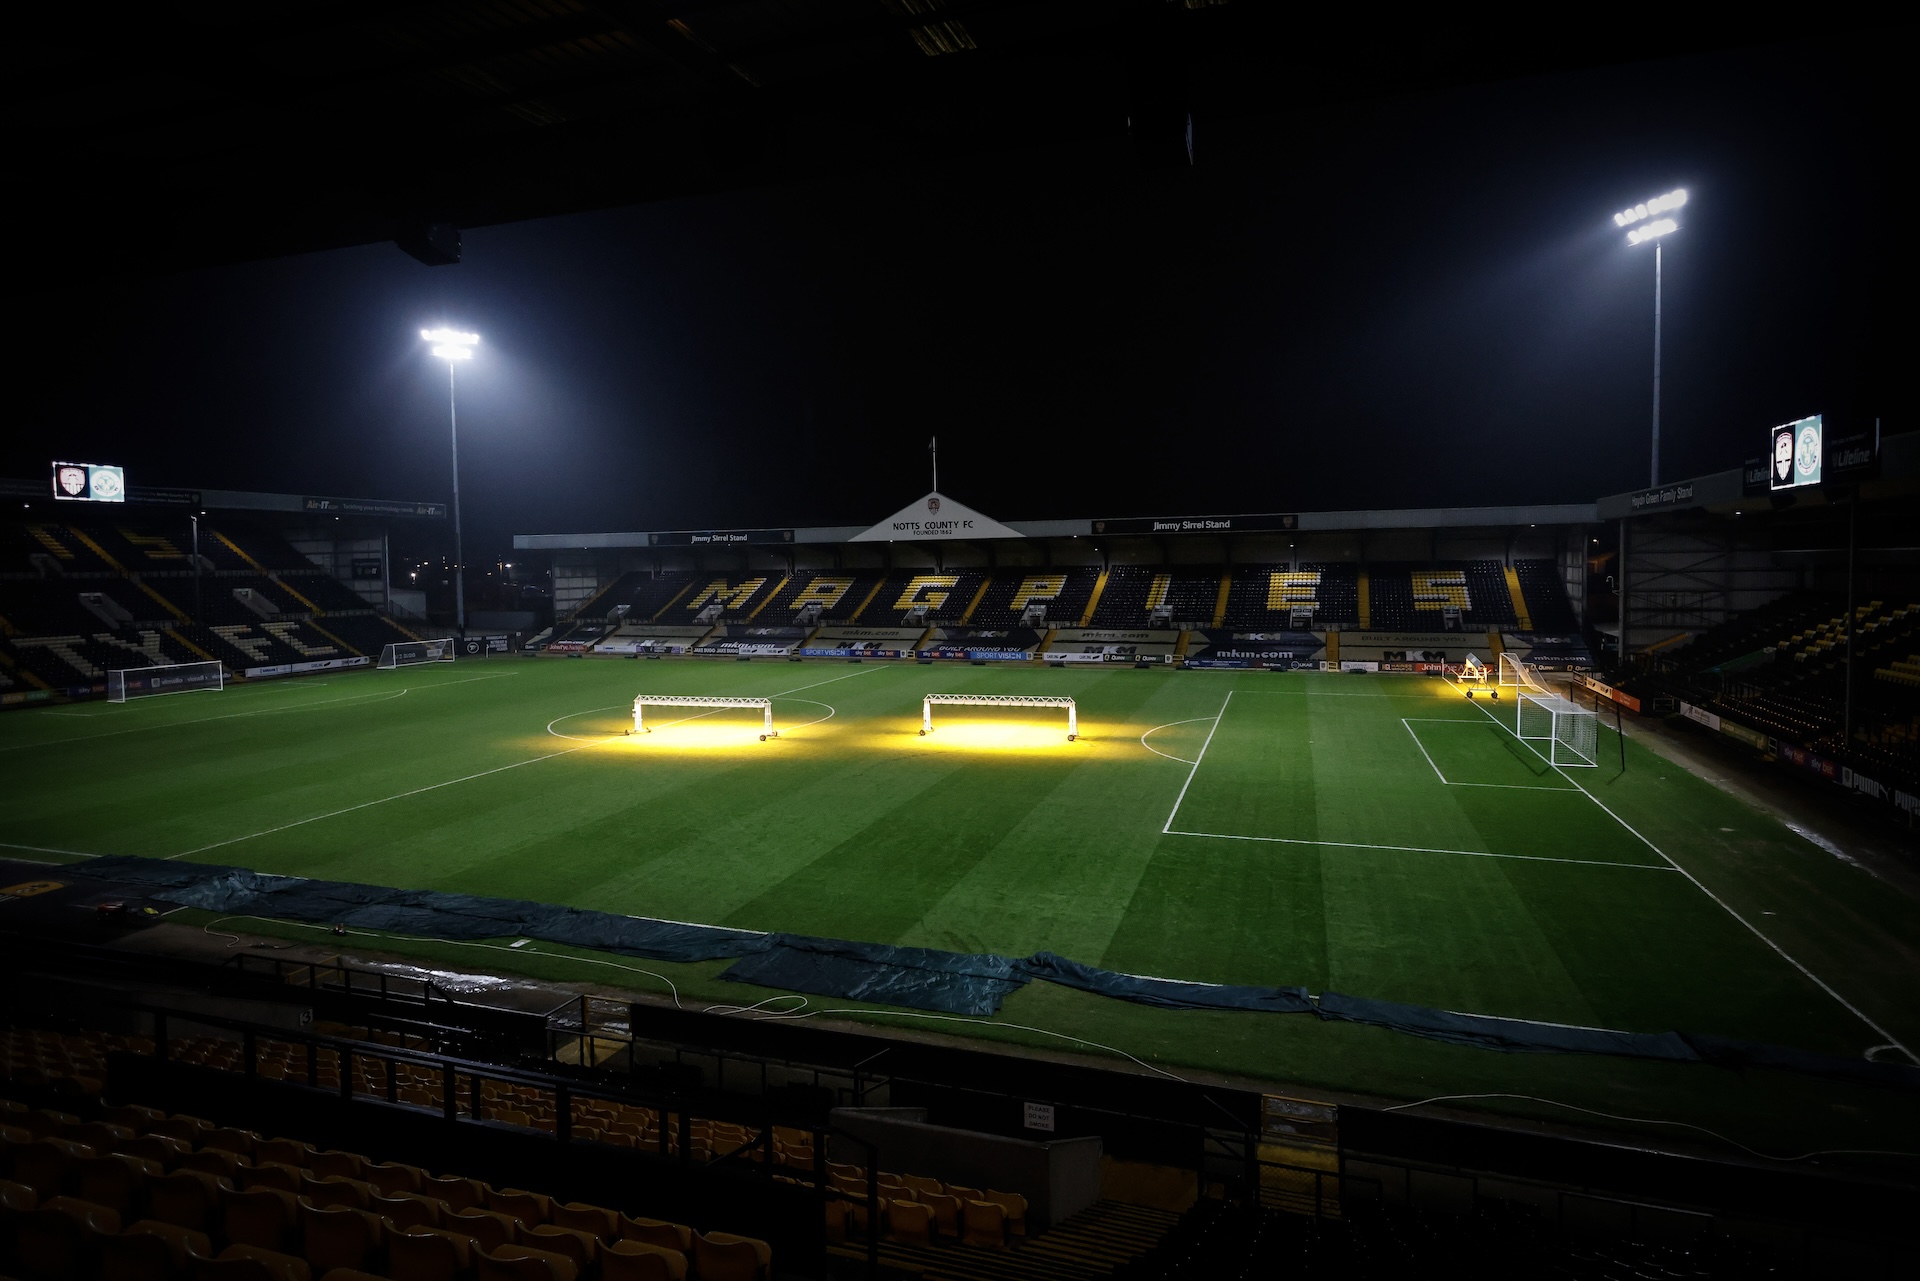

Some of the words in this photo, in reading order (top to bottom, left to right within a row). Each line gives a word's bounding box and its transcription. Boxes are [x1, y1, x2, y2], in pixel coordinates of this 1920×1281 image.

[1645, 493, 1659, 504] Green
[1660, 490, 1676, 503] Family
[1677, 484, 1693, 499] Stand
[893, 522, 920, 530] NOTTS
[924, 521, 959, 529] COUNTY
[963, 520, 974, 528] FC
[1153, 521, 1180, 531] Jimmy
[1182, 521, 1204, 529] Sirrel
[1205, 520, 1231, 529] Stand
[691, 535, 711, 544] Jimmy
[967, 630, 1010, 638] MKM
[1232, 632, 1281, 641] MKM
[836, 641, 884, 650] MKM
[1083, 646, 1137, 654] MKM
[1216, 649, 1294, 659] mkm.com
[1383, 650, 1447, 662] MKM
[1421, 663, 1441, 671] John
[1895, 789, 1920, 816] PUM
[302, 1011, 311, 1024] 3
[1028, 1105, 1050, 1113] PLEASE
